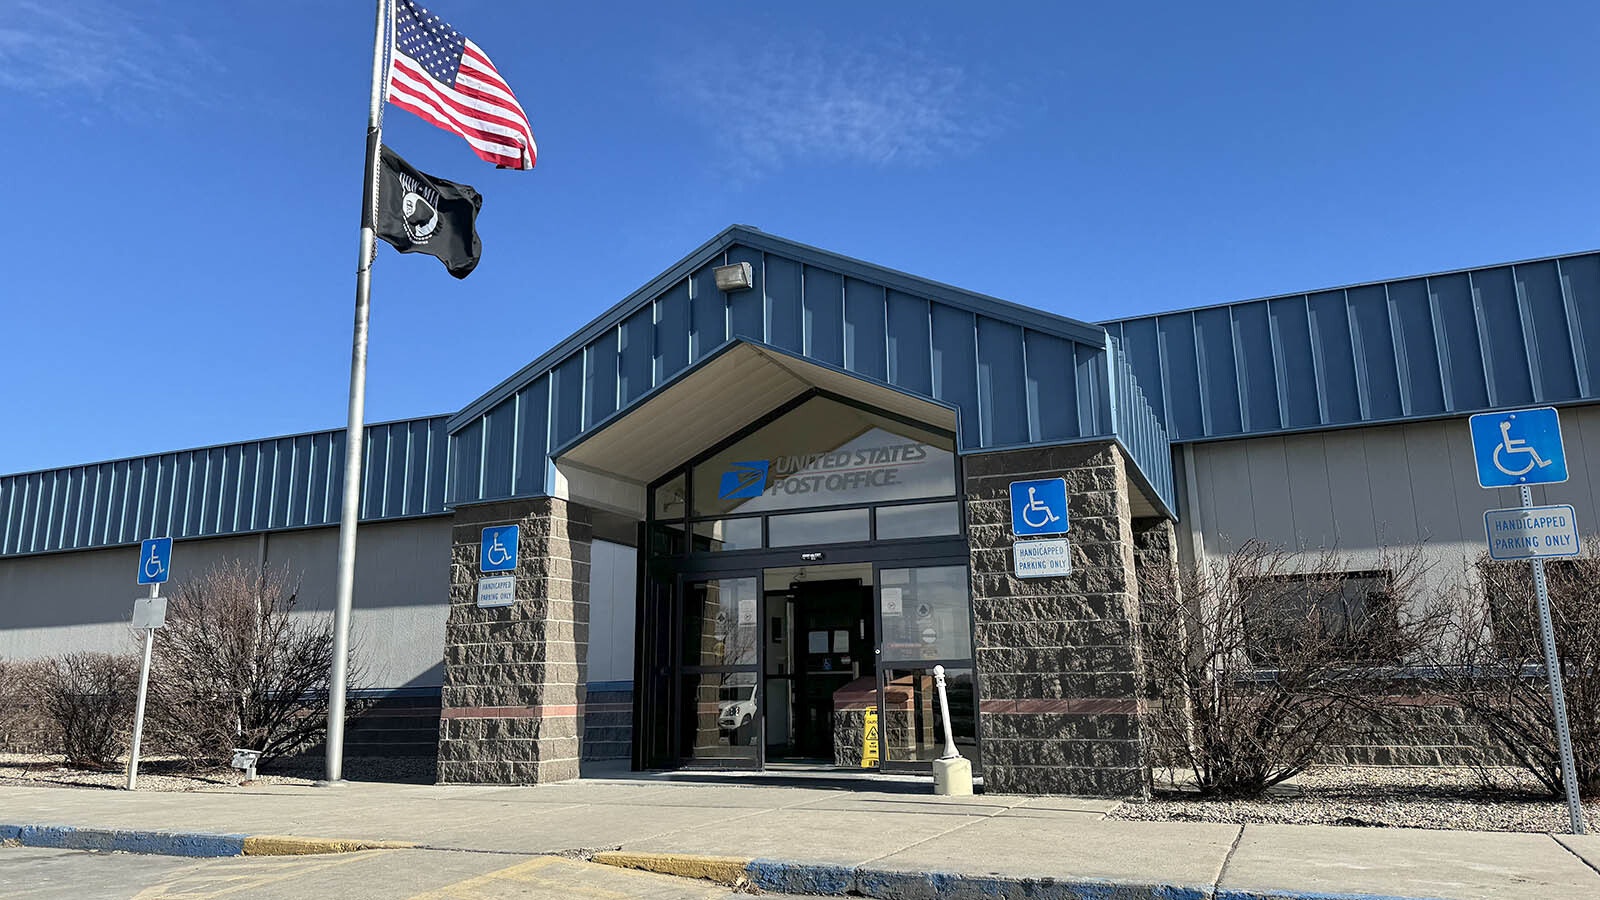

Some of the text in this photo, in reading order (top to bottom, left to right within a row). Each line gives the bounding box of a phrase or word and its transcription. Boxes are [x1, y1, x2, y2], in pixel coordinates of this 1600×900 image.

[775, 443, 926, 474] UNITED STATES
[771, 468, 898, 496] POST OFFICE
[1495, 516, 1566, 531] HANDICAPPED
[1495, 534, 1571, 550] PARKING ONLY
[1019, 546, 1064, 557] HANDICAPPED
[1019, 559, 1066, 570] PARKING ONLY
